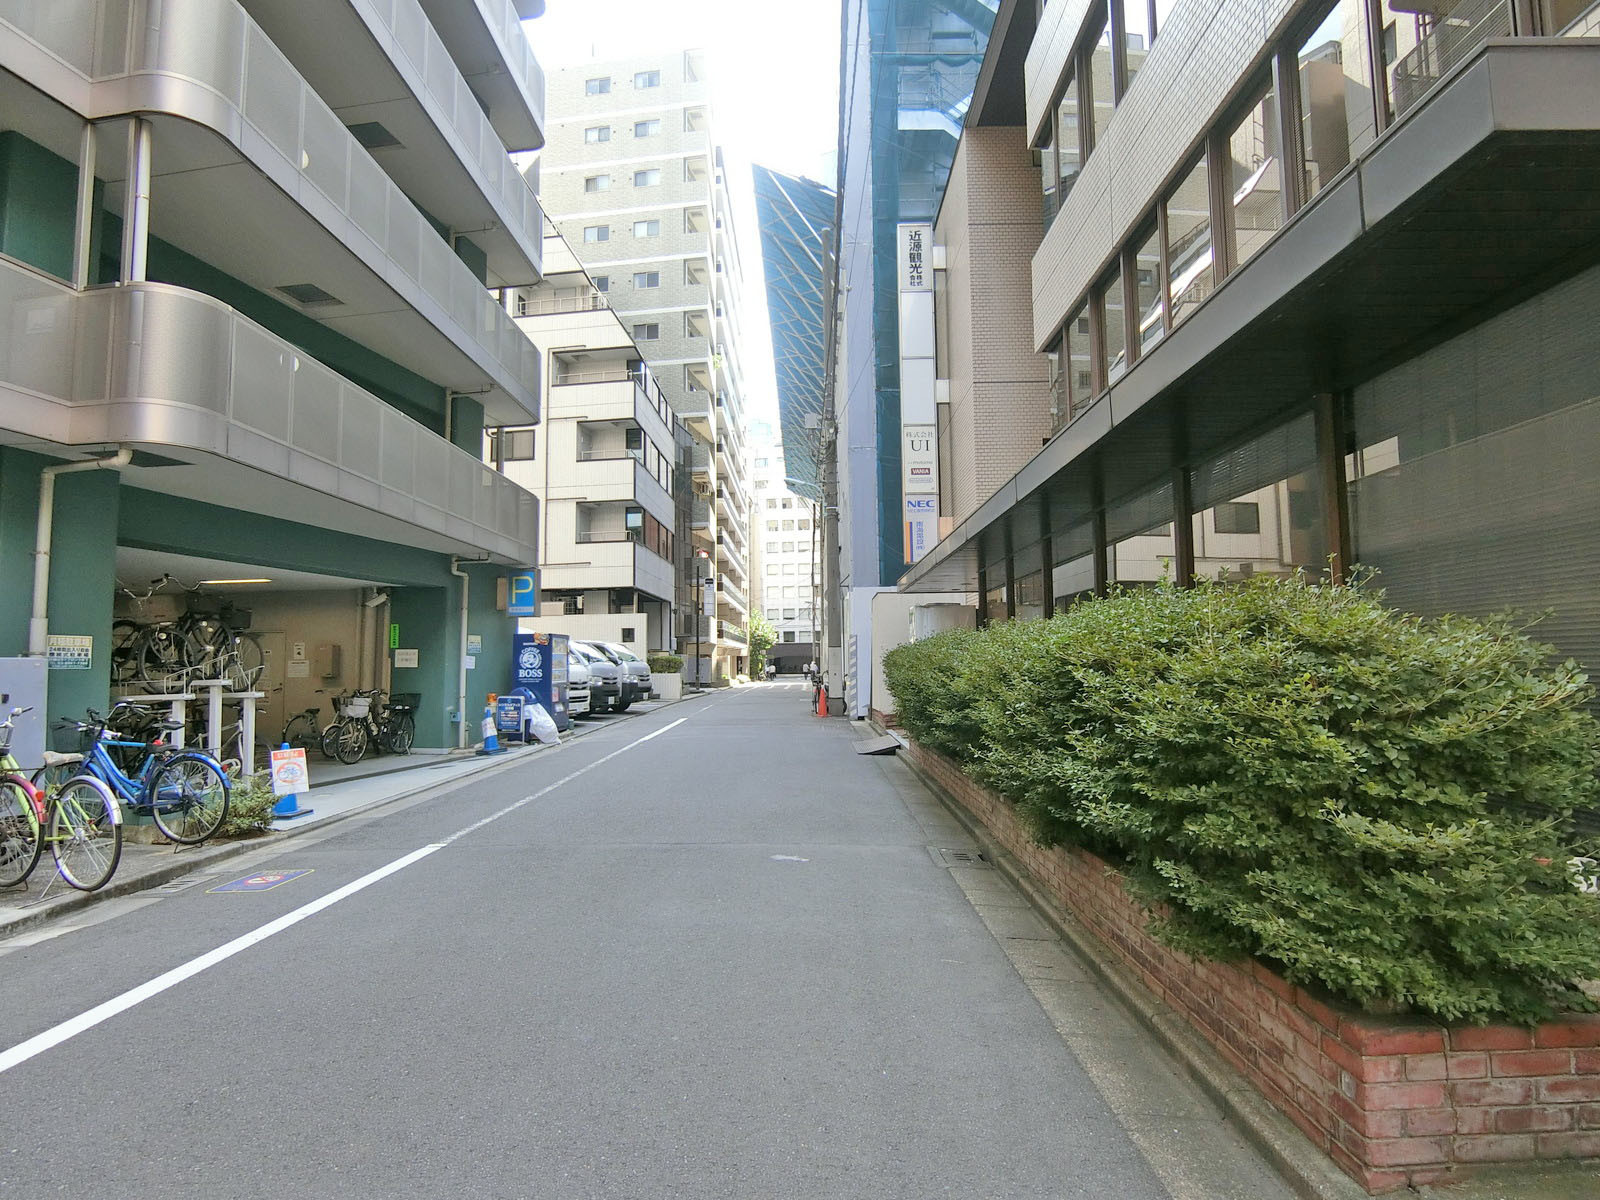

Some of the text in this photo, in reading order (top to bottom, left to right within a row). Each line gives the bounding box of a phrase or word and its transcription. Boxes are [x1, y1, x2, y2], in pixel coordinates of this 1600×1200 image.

[911, 439, 930, 452] UI
[907, 499, 935, 508] NEC
[511, 576, 533, 604] P
[518, 669, 543, 678] BOSS
